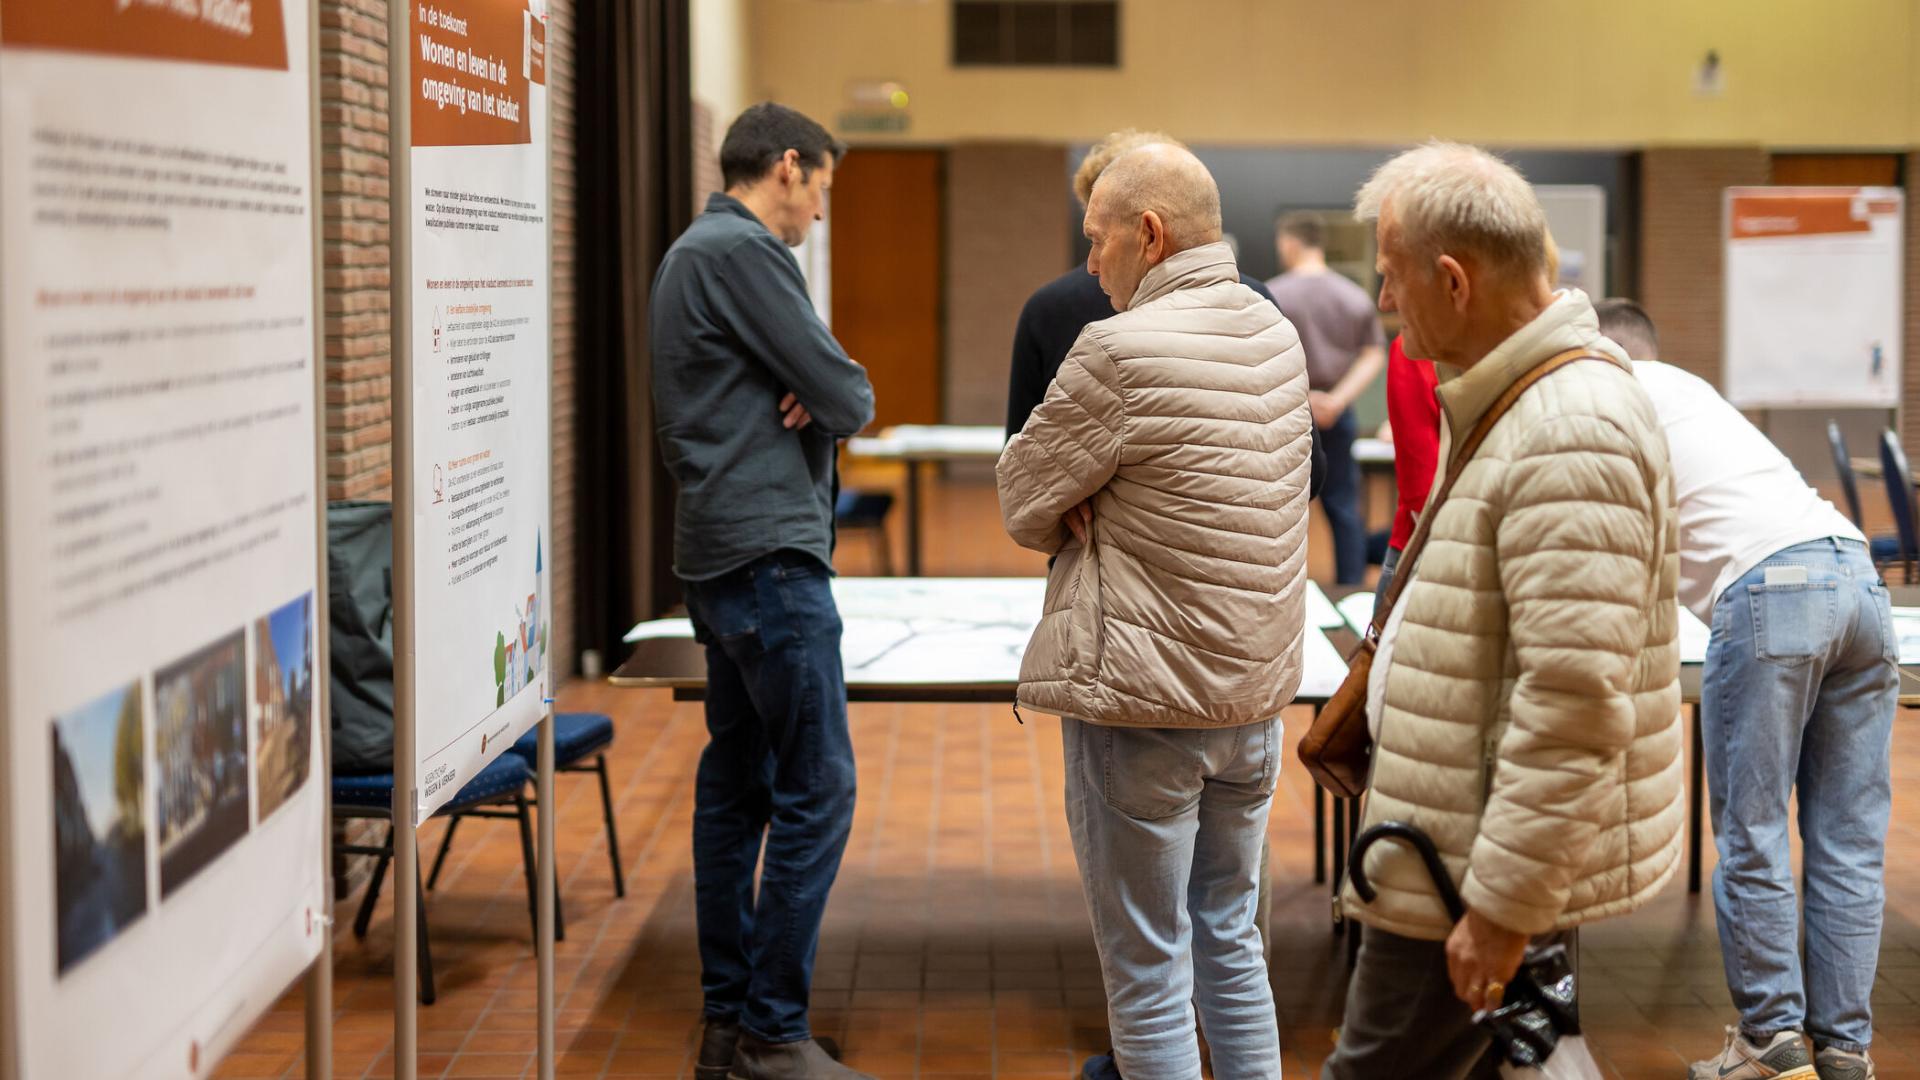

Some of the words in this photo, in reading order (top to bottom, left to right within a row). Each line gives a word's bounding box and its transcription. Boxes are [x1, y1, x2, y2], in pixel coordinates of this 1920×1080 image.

[419, 3, 426, 23] In
[427, 8, 438, 26] de
[439, 12, 468, 37] toekomst
[420, 34, 455, 68] Wonen
[457, 48, 467, 73] en
[468, 47, 488, 79] leven
[490, 55, 497, 81] in
[498, 59, 507, 86] de
[422, 78, 466, 115] omgeving
[467, 89, 481, 113] van
[482, 87, 496, 115] het
[496, 93, 520, 123] viaduct
